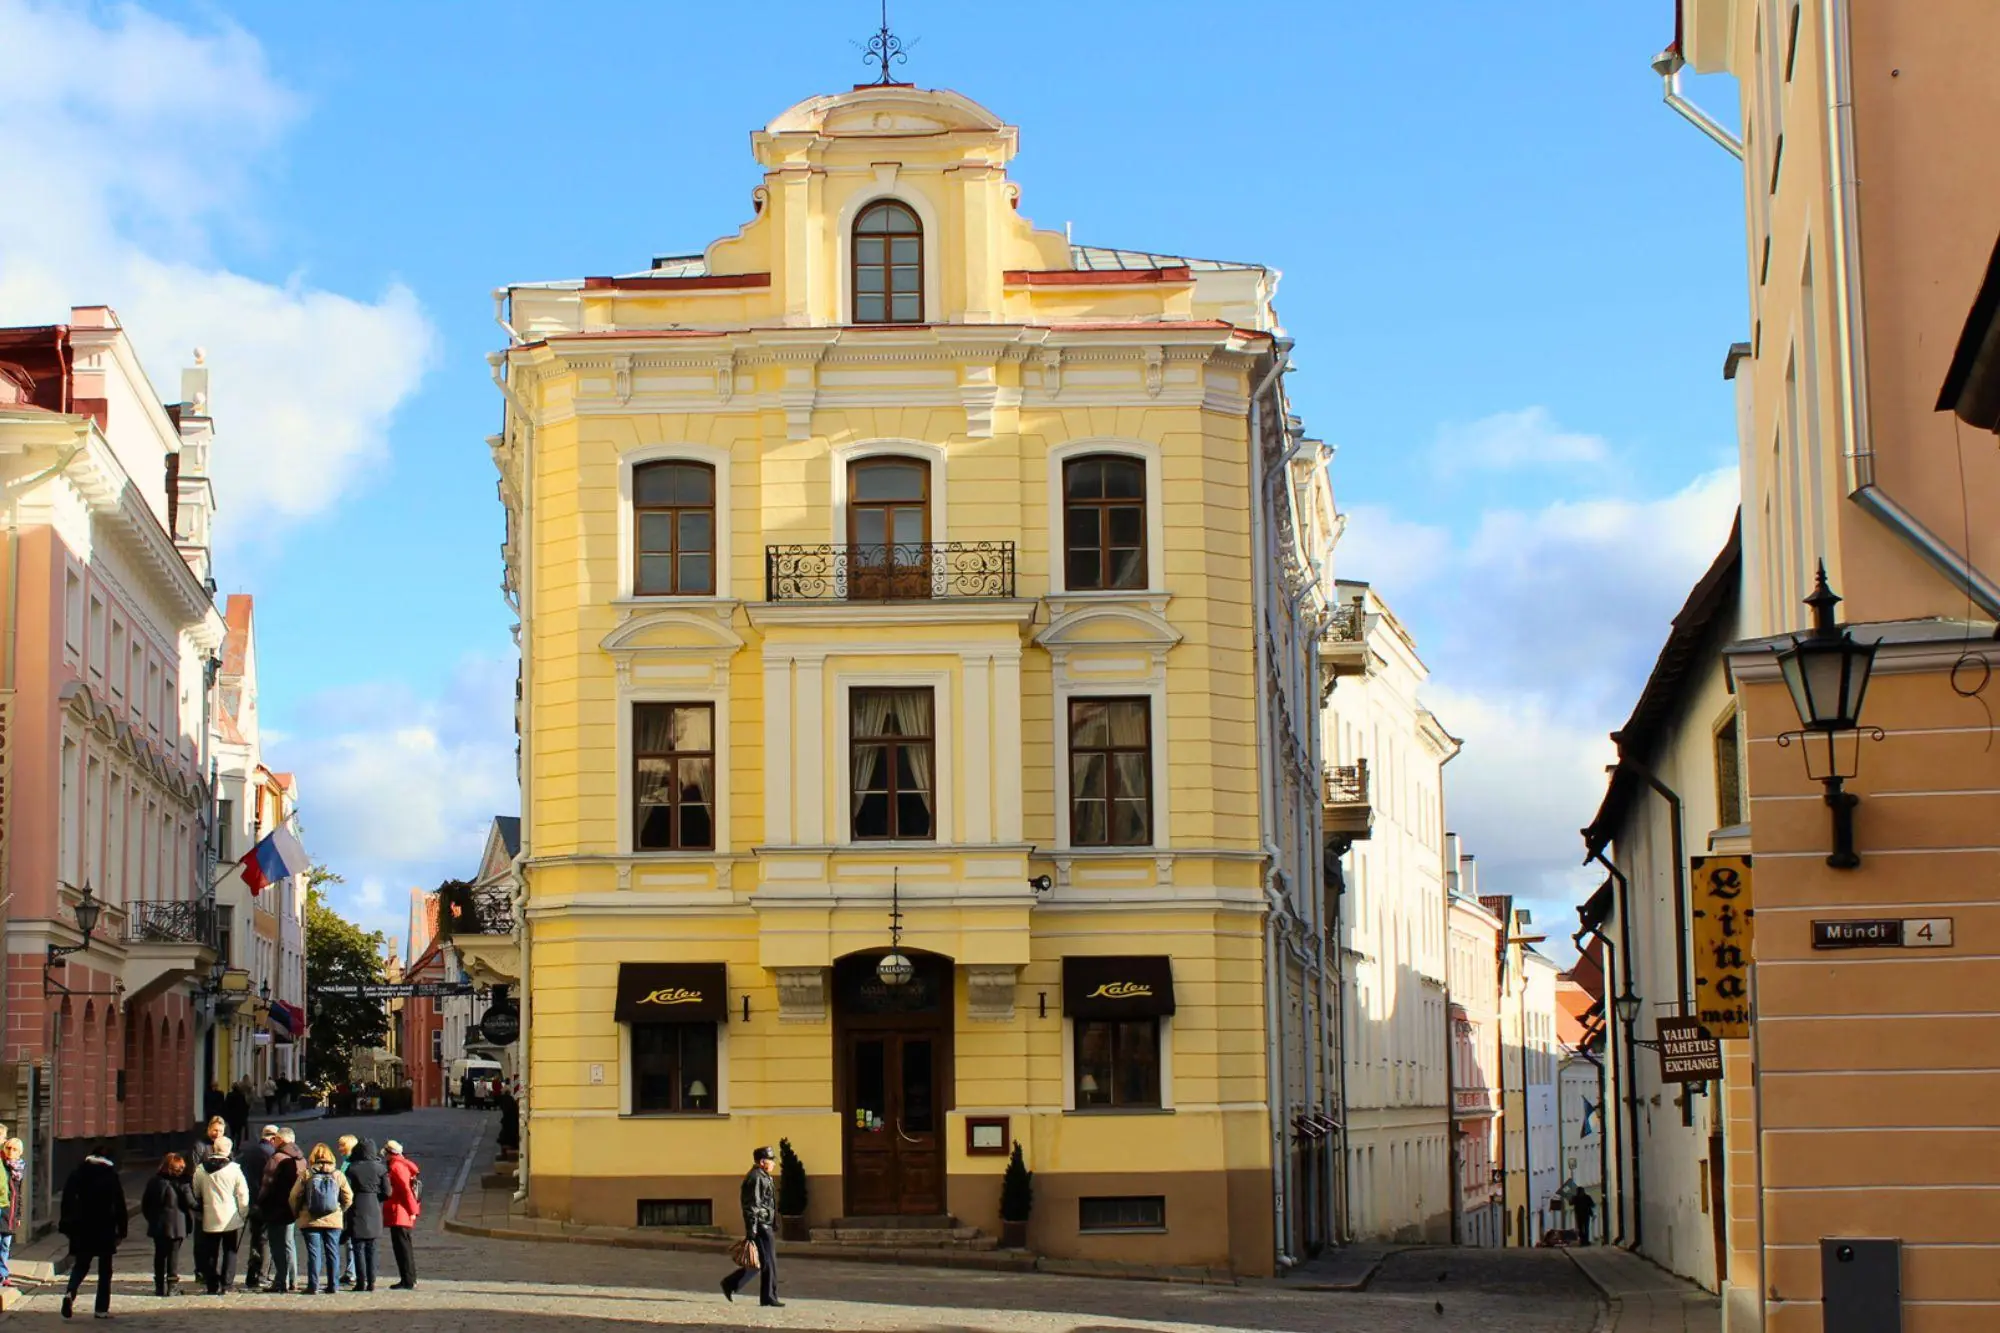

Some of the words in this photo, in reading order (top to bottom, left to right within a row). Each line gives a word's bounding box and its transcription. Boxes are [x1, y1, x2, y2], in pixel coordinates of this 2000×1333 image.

[1826, 925, 1886, 939] Mündi
[1917, 922, 1933, 941] 4
[636, 988, 703, 1004] Kalev
[1086, 982, 1153, 998] Kalev
[1662, 1028, 1698, 1041] VALUU
[1664, 1039, 1716, 1054] VAHETUS
[1665, 1057, 1719, 1072] EXCHANGE
